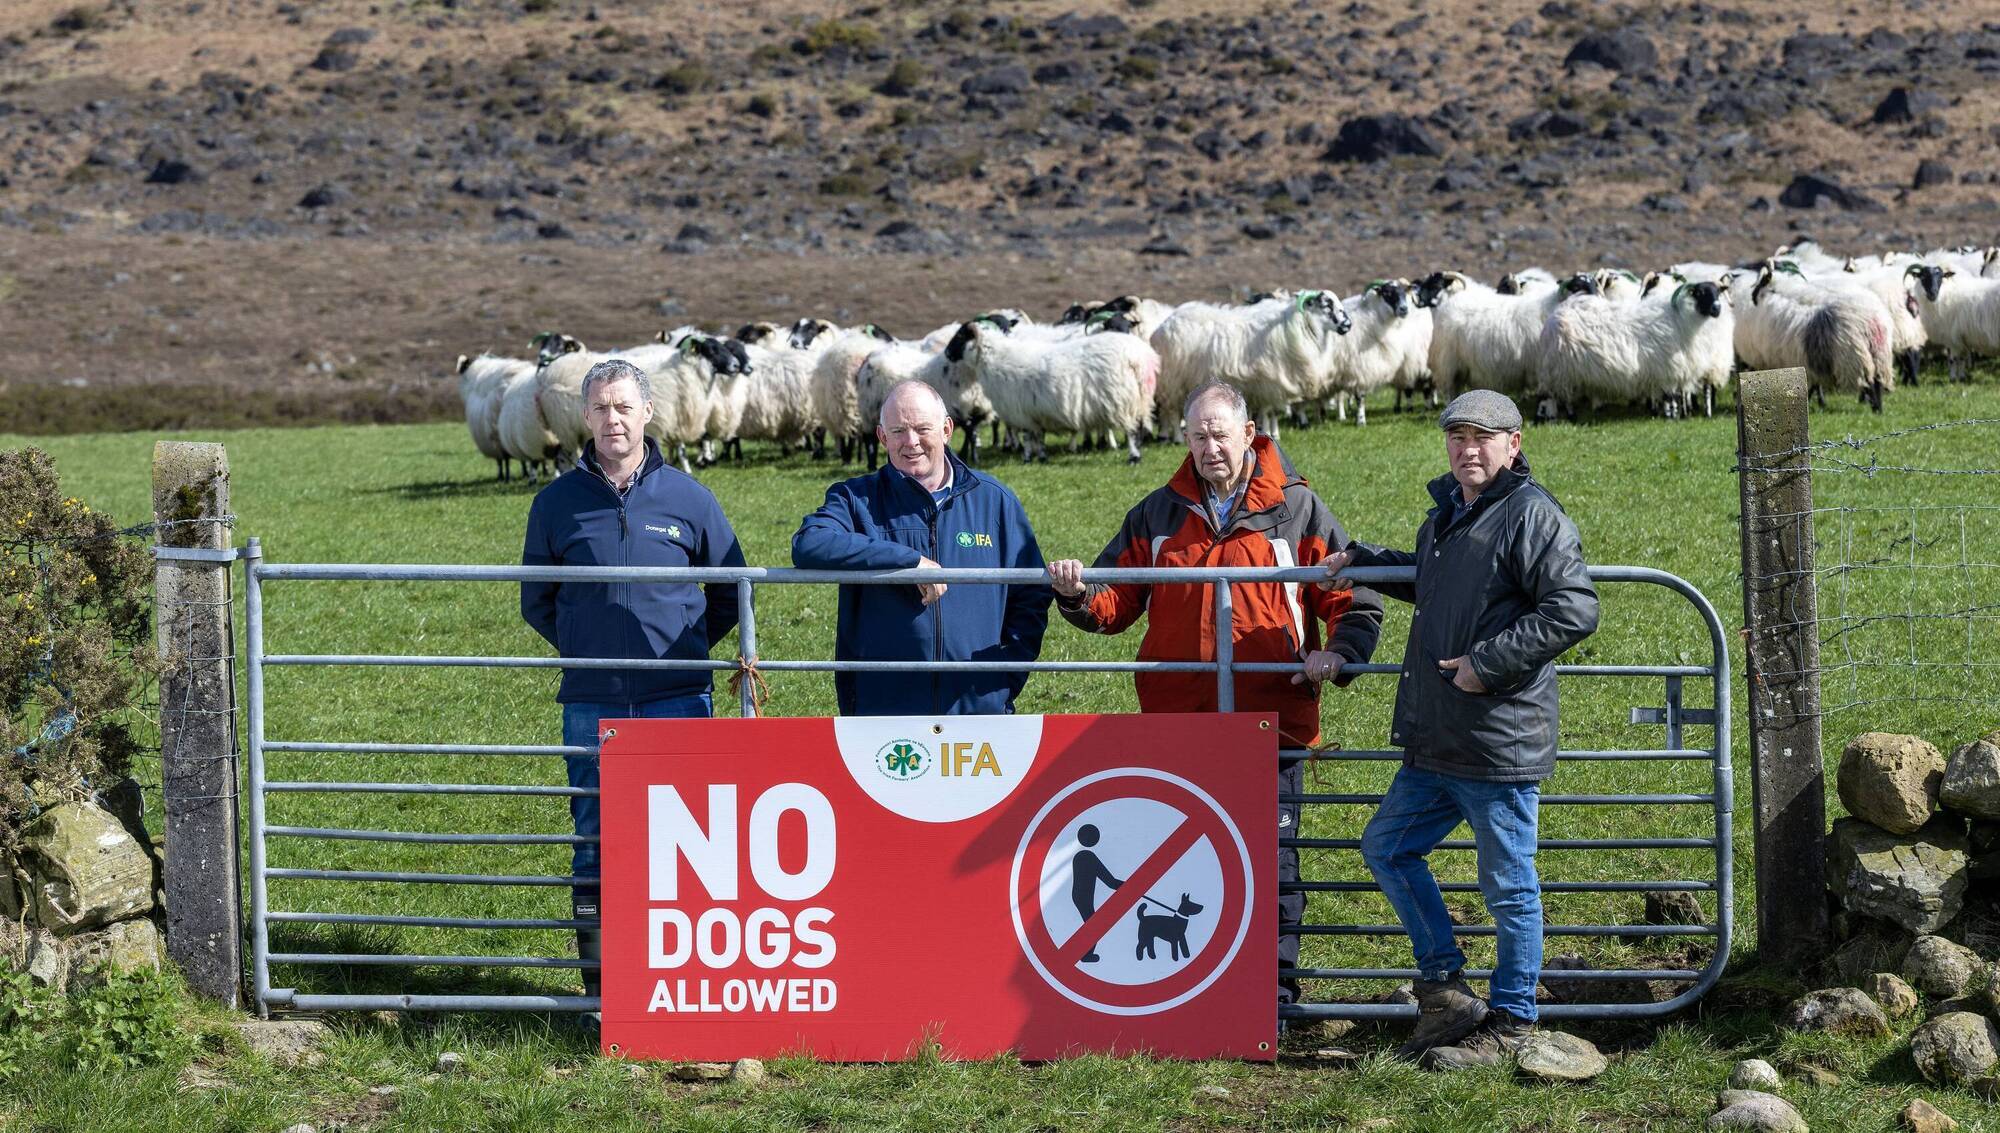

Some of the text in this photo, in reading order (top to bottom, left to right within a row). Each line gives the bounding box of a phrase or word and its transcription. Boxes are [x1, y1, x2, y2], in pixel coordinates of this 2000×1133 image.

[975, 533, 993, 547] IFA
[941, 743, 1003, 776] IFA
[648, 782, 837, 901] NO
[648, 907, 837, 969] DOGS
[647, 978, 838, 1013] ALLOWED
